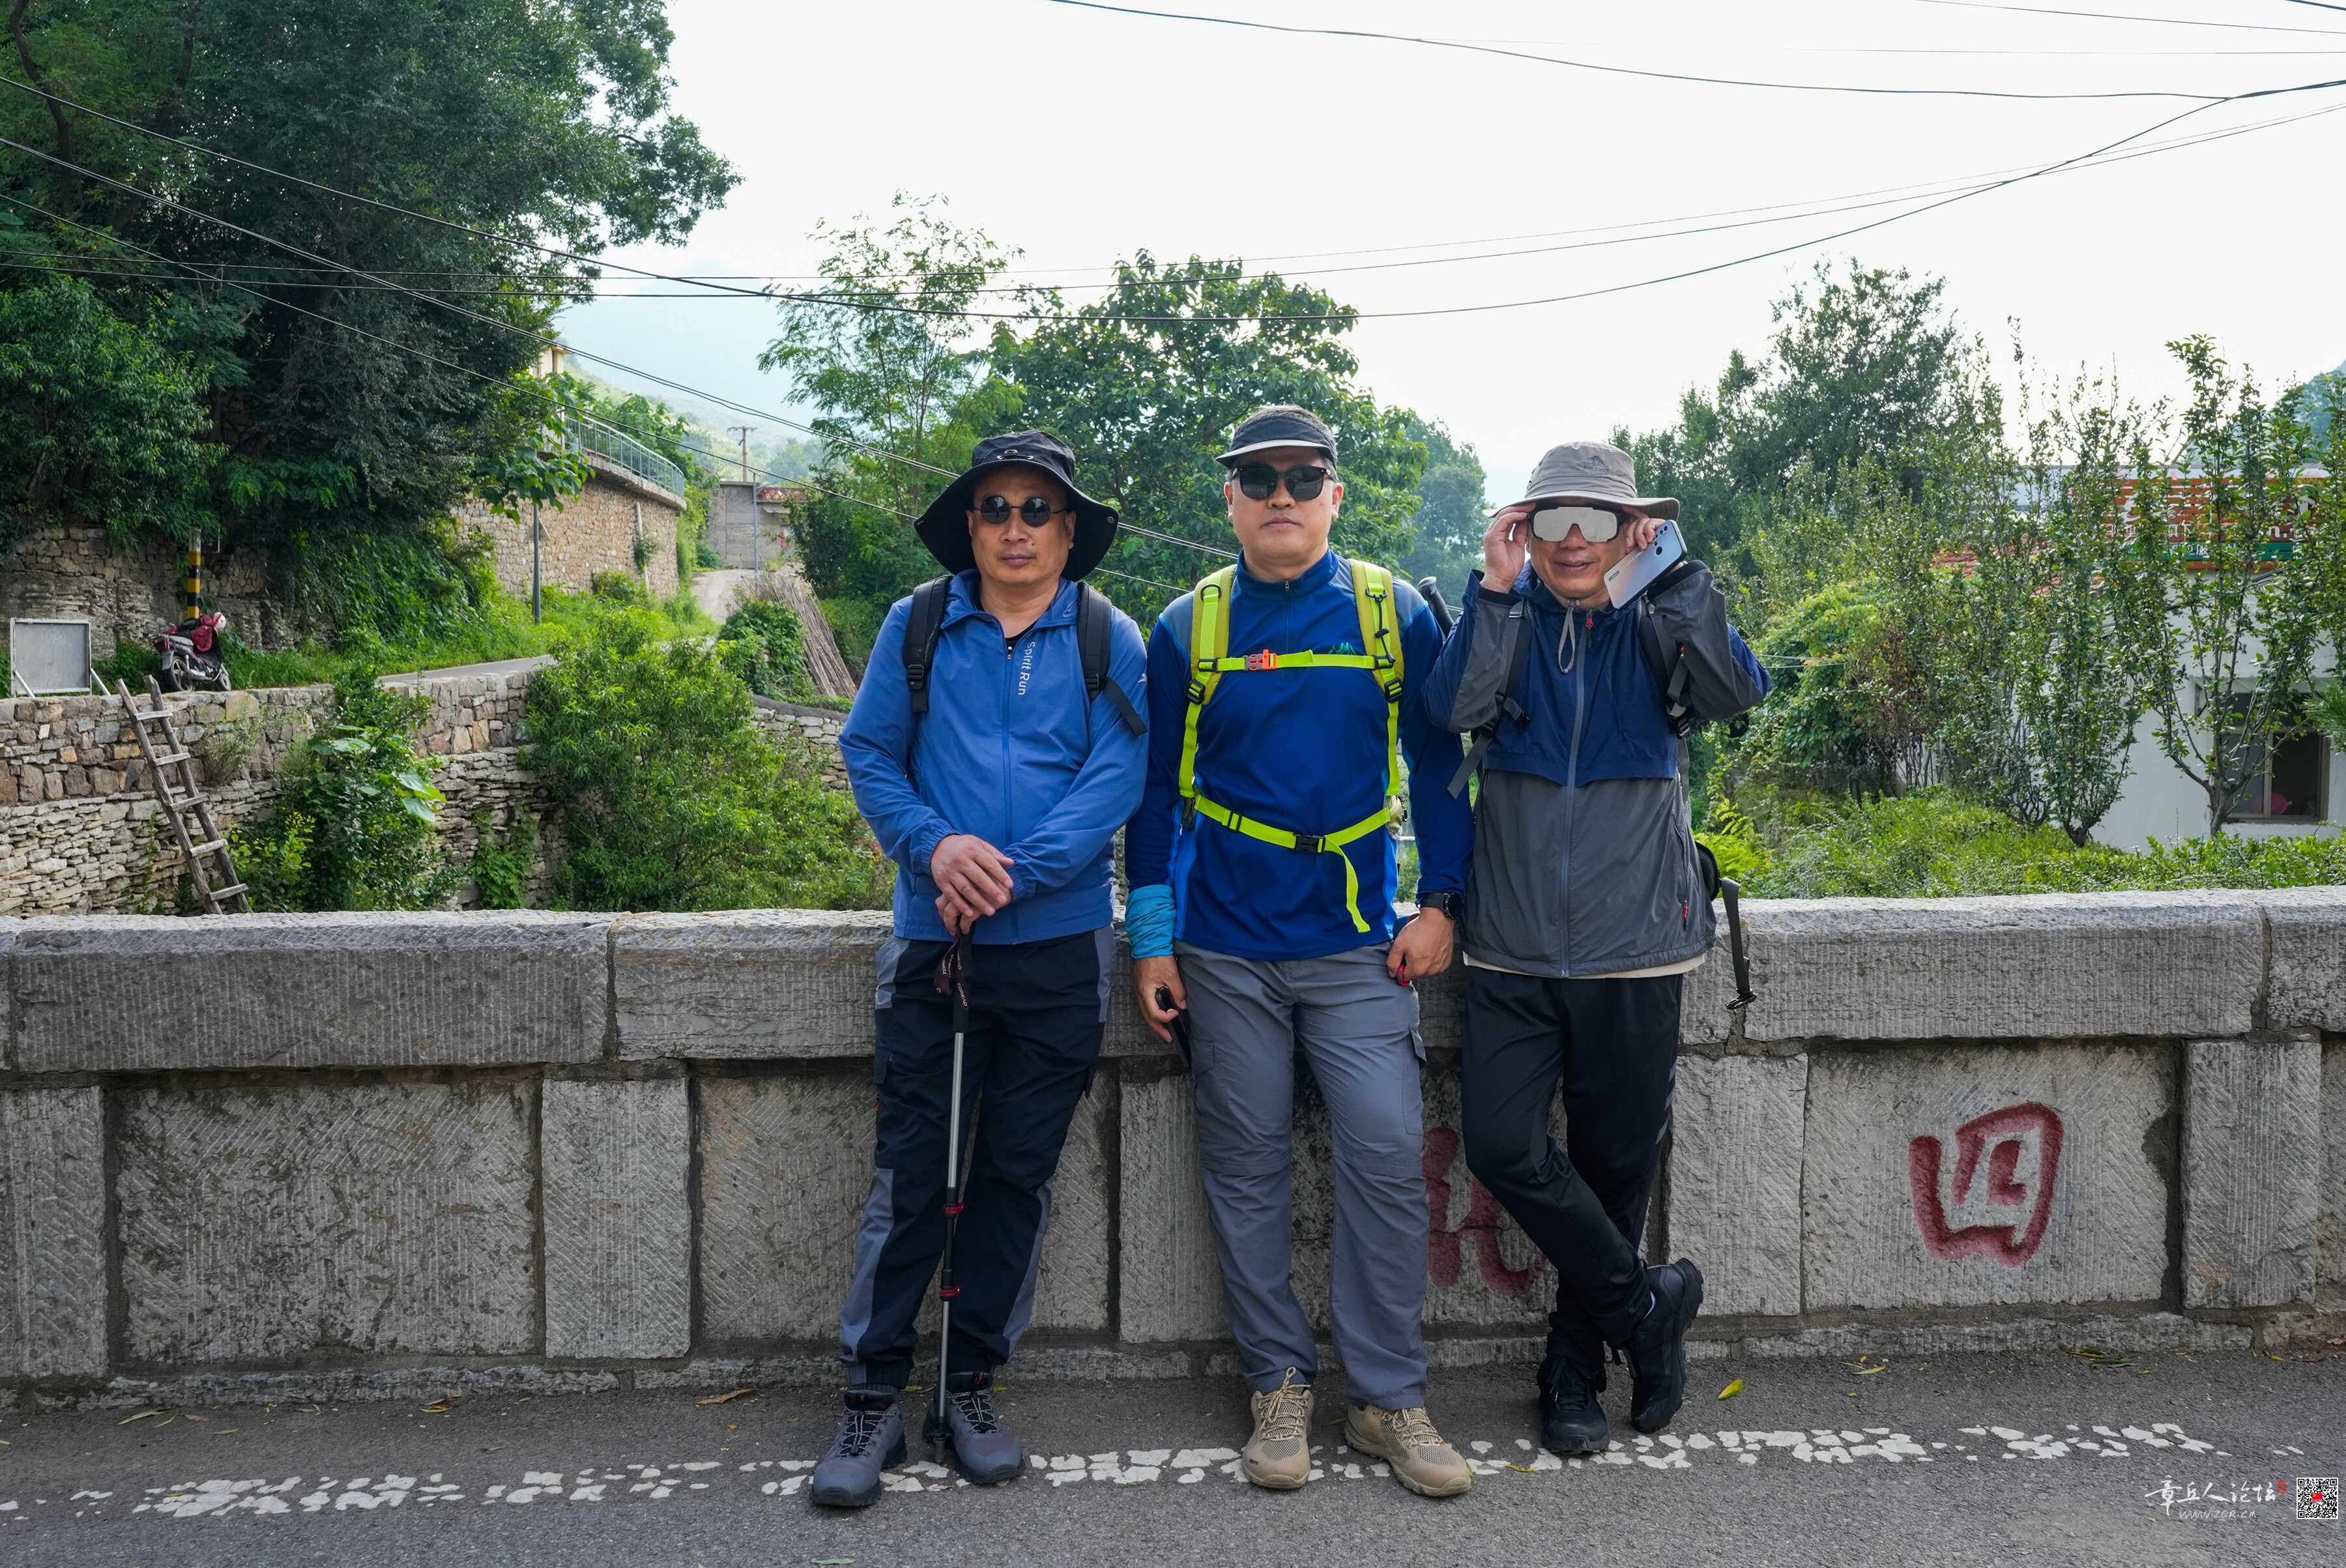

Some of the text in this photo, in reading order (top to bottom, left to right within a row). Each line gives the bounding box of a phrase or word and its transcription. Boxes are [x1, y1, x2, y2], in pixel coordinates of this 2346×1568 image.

[1018, 641, 1035, 695] Spirit Run
[957, 982, 968, 1007] TOREAD
